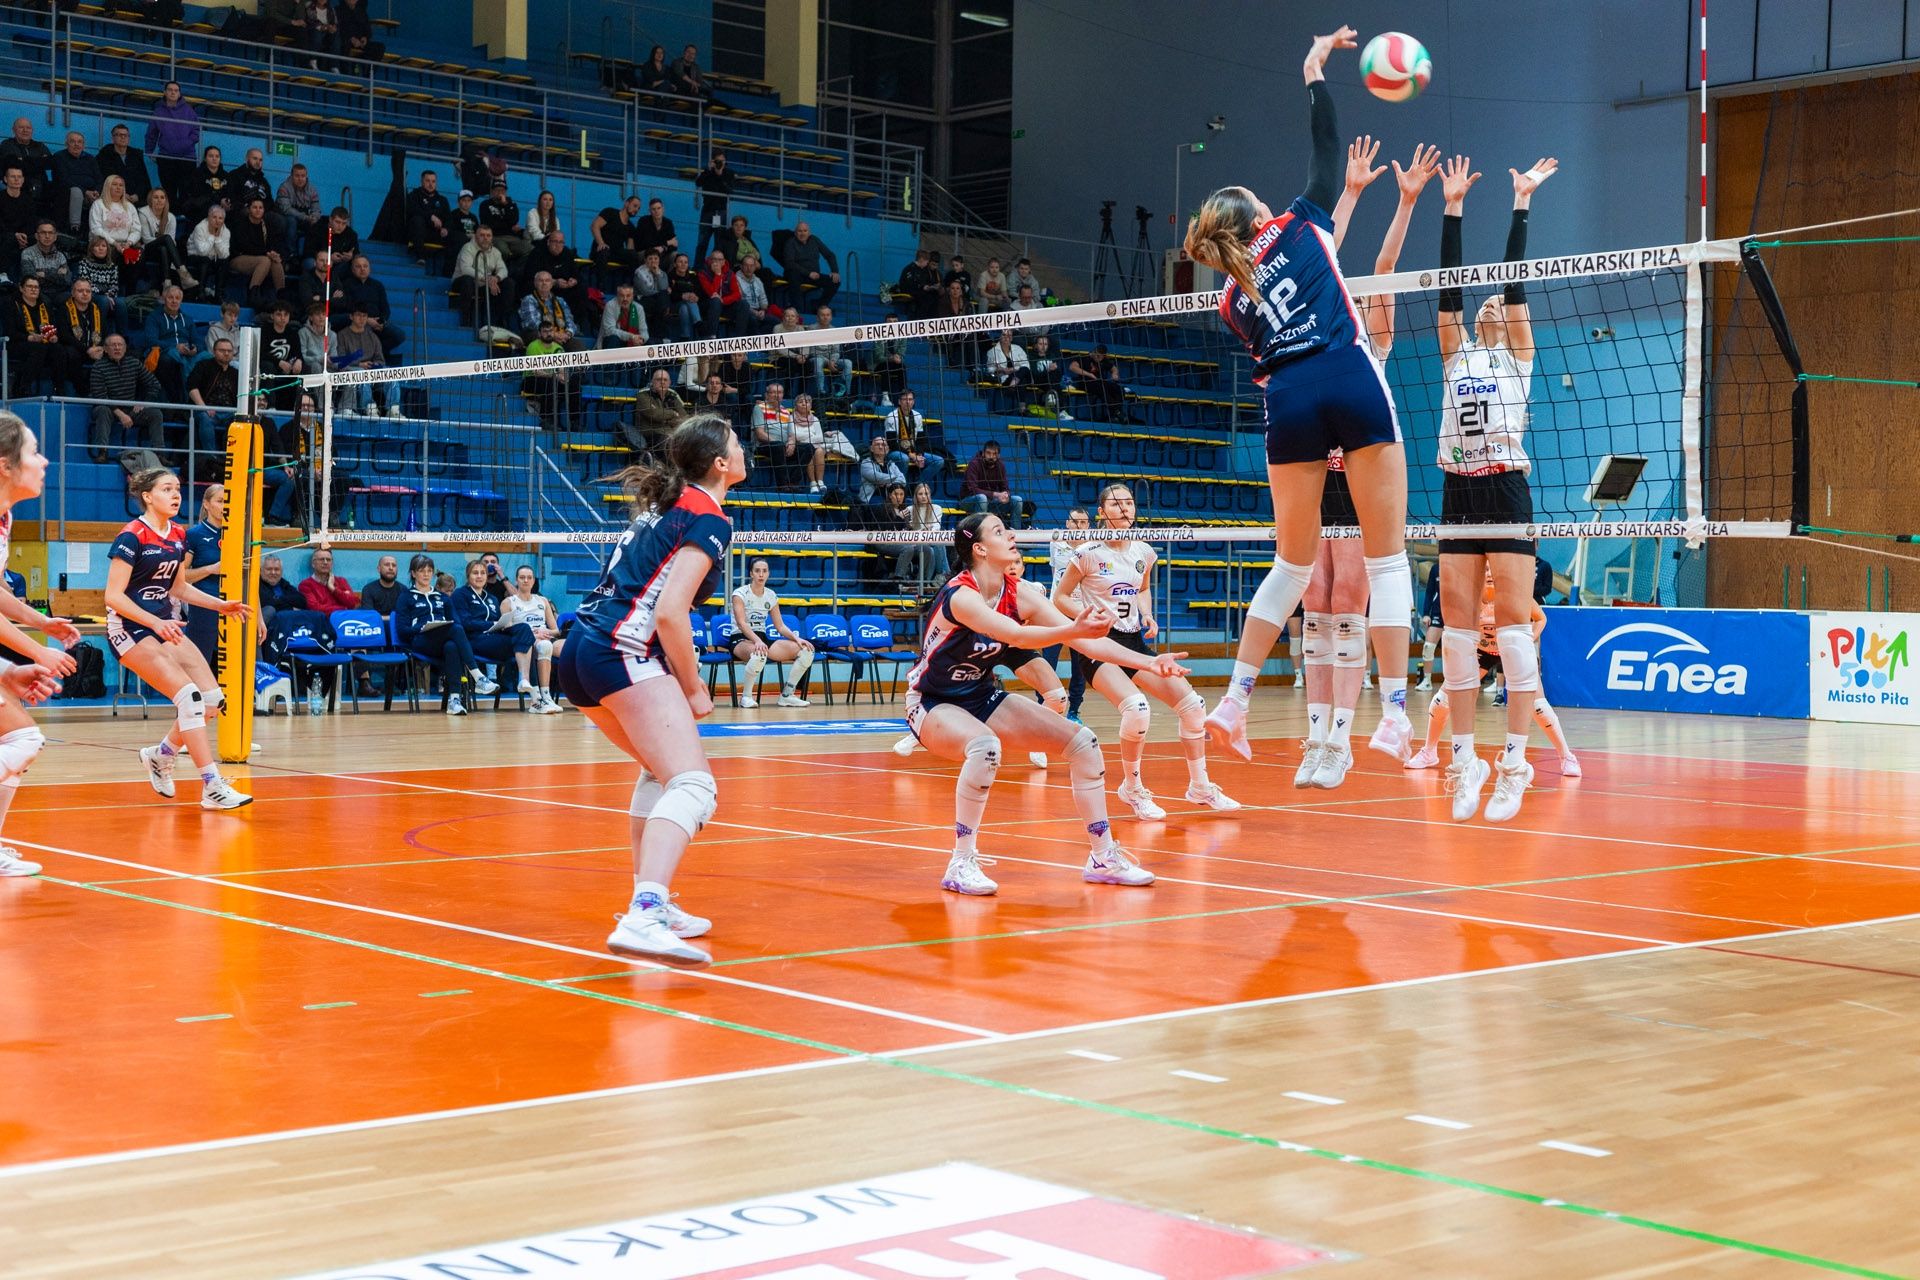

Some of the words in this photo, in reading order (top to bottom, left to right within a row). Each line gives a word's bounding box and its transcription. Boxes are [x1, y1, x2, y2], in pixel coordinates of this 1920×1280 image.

[1438, 269, 1481, 287] ENEA
[1486, 264, 1530, 283] KLUB
[1534, 254, 1636, 279] SIATKARSKI
[1641, 247, 1682, 267] PIŁA
[1121, 299, 1155, 316] ENEA
[1158, 296, 1193, 313] KLUB
[1255, 277, 1307, 333] 12
[866, 325, 896, 340] ENEA
[898, 323, 926, 337] KLUB
[928, 315, 993, 335] SIATKARSKI
[995, 312, 1022, 329] PIŁA
[657, 344, 681, 358] ENEA
[683, 342, 707, 356] KLUB
[708, 337, 762, 353] SIATKARSKI
[764, 334, 786, 349] PIŁA
[482, 360, 502, 372] ENEA
[503, 358, 525, 371] KLUB
[525, 354, 570, 369] SIATKARSKI
[572, 351, 591, 366] PIŁA
[333, 372, 350, 384] ENEA
[351, 371, 369, 383] KLUB
[370, 367, 408, 382] SIATKARSKI
[409, 366, 426, 379] PIŁA
[1457, 384, 1497, 396] Enea
[1460, 400, 1489, 427] 21
[339, 532, 352, 541] ENEA
[353, 532, 366, 541] KLUB
[366, 532, 394, 541] SIATKARSKI
[395, 532, 407, 541] PIŁA
[449, 532, 464, 541] ENEA
[465, 532, 479, 541] KLUB
[480, 532, 513, 541] SIATKARSKI
[513, 532, 526, 541] PIŁA
[574, 532, 589, 542] ENEA
[590, 532, 604, 542] KLUB
[734, 532, 752, 542] KLUB
[753, 532, 795, 542] SIATKARSKI
[796, 532, 813, 542] PIŁA
[875, 532, 897, 542] ENEA
[898, 532, 920, 542] KLUB
[921, 532, 955, 542] SIATKAR
[1062, 530, 1087, 541] ENEA
[1089, 530, 1113, 541] KLUB
[1115, 530, 1170, 541] SIATKARSKI
[1171, 530, 1194, 541] PIŁA
[1411, 526, 1437, 538] PIŁA
[1540, 524, 1575, 537] ENEA
[1577, 524, 1613, 537] KLUB
[152, 560, 179, 579] 20
[1118, 602, 1131, 619] 3
[344, 625, 382, 637] Enea
[817, 629, 847, 638] Enea
[861, 629, 889, 638] Enea
[1606, 649, 1748, 696] Enea
[1838, 662, 1888, 689] 500
[1827, 689, 1877, 704] Miasto
[1880, 692, 1910, 706] Piła
[330, 1187, 933, 1280] WORKIN
